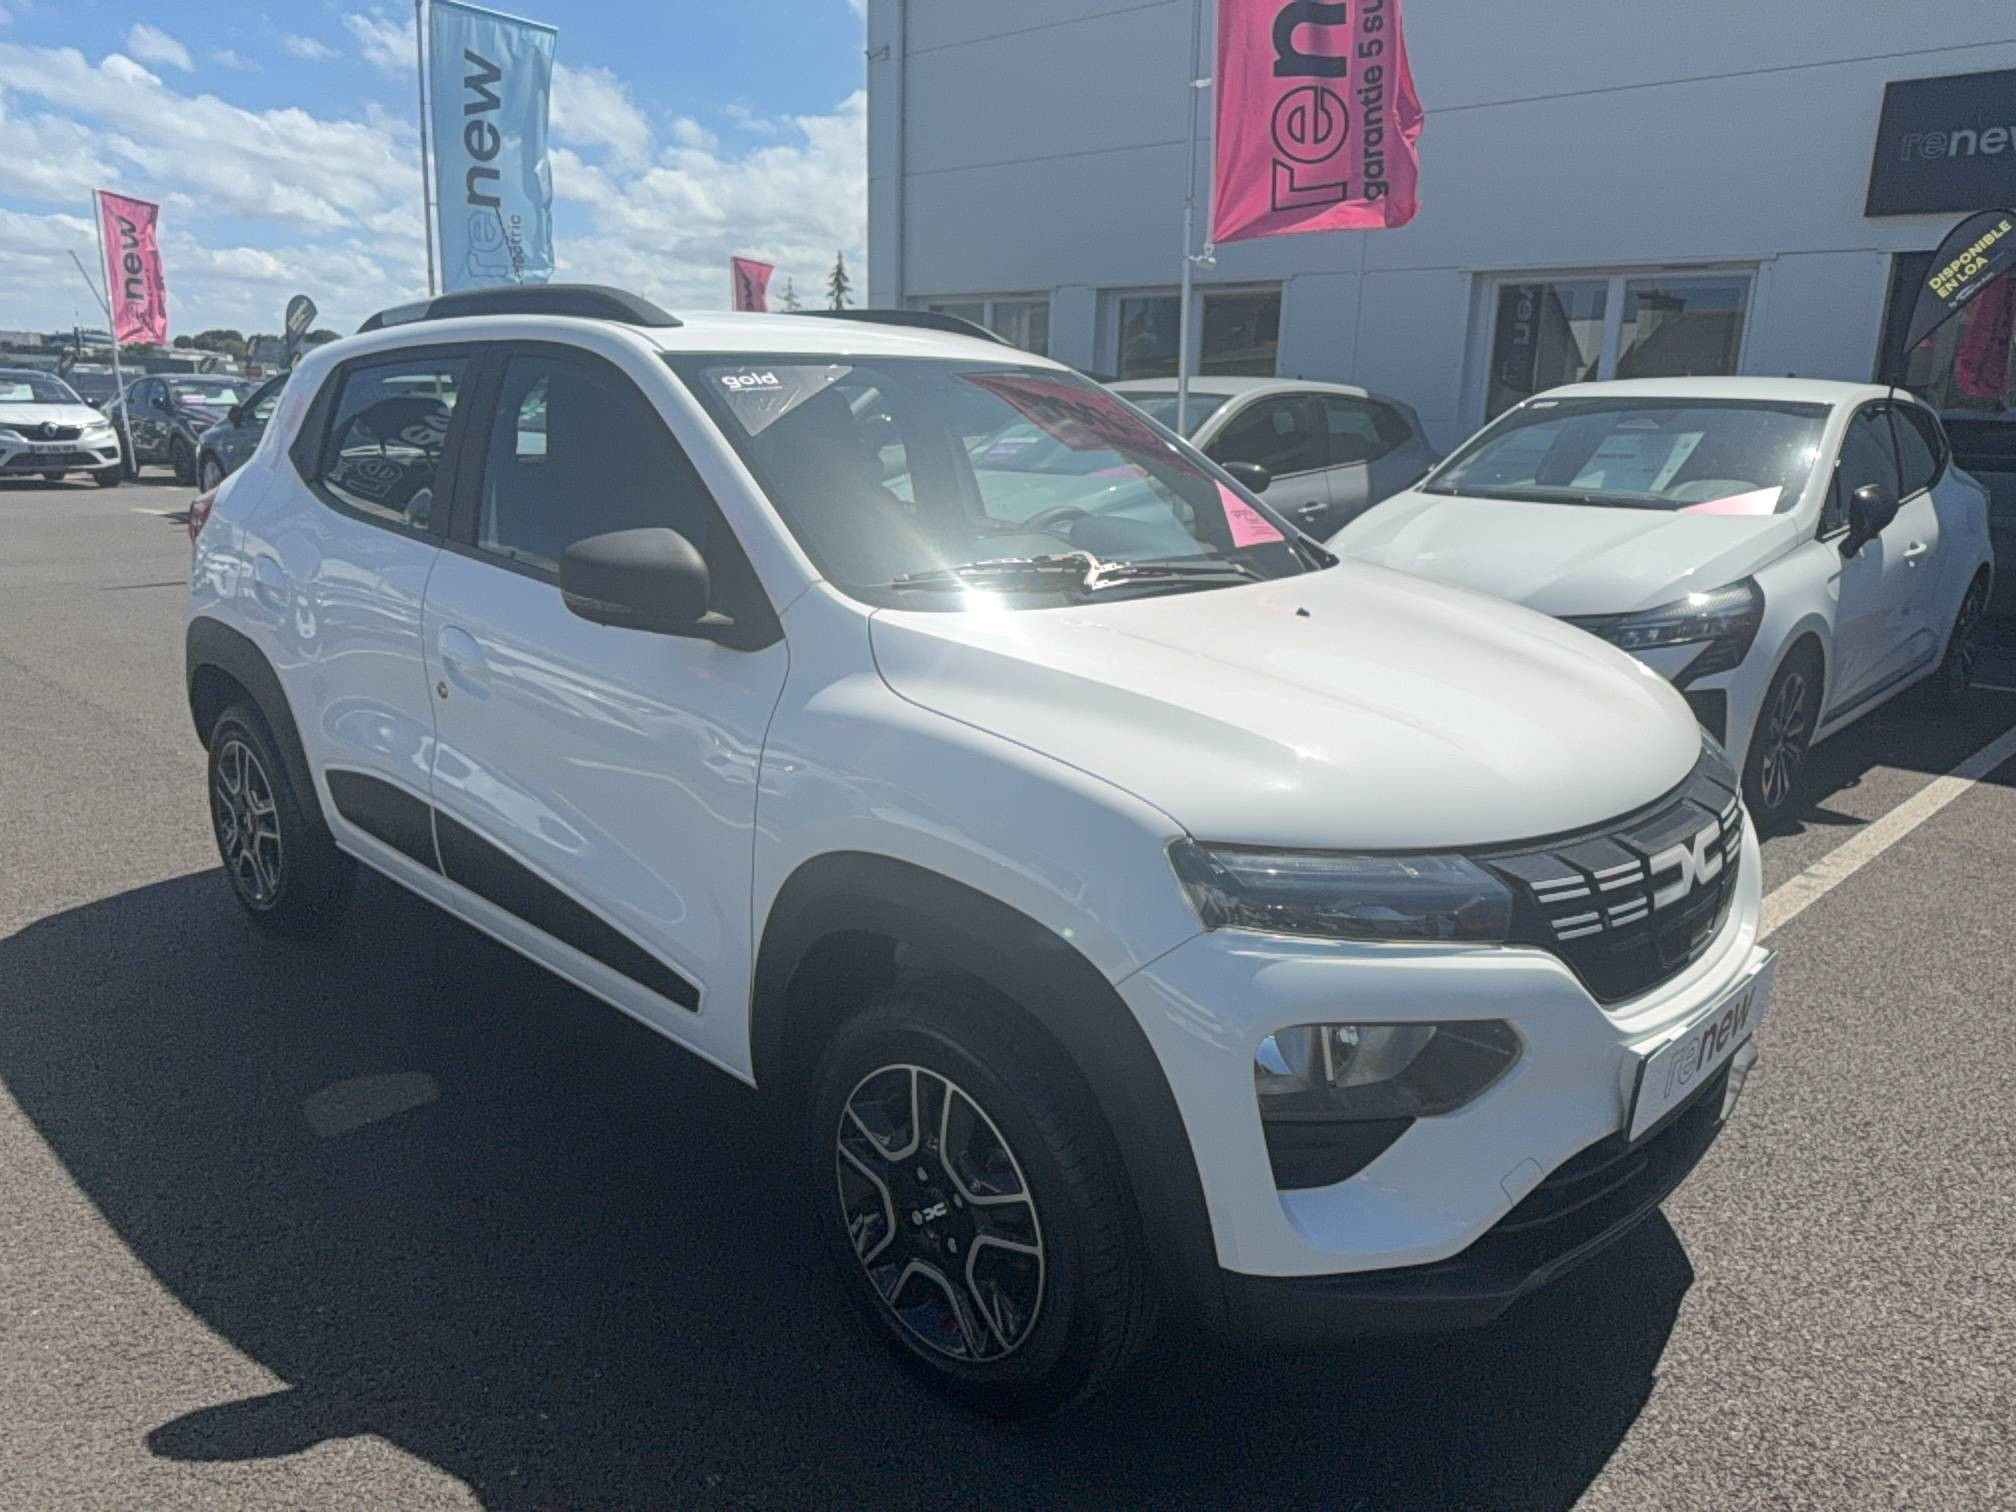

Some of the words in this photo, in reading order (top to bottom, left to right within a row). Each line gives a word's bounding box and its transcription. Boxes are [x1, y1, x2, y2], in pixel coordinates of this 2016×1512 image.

[1358, 38, 1384, 59] 5
[464, 48, 508, 278] renew
[1357, 64, 1389, 201] garantie
[1928, 219, 2012, 289] DISPONIBLE
[1936, 278, 1960, 298] EN
[1956, 256, 1989, 282] LOA
[721, 371, 779, 389] gold
[1665, 986, 1757, 1098] renew
